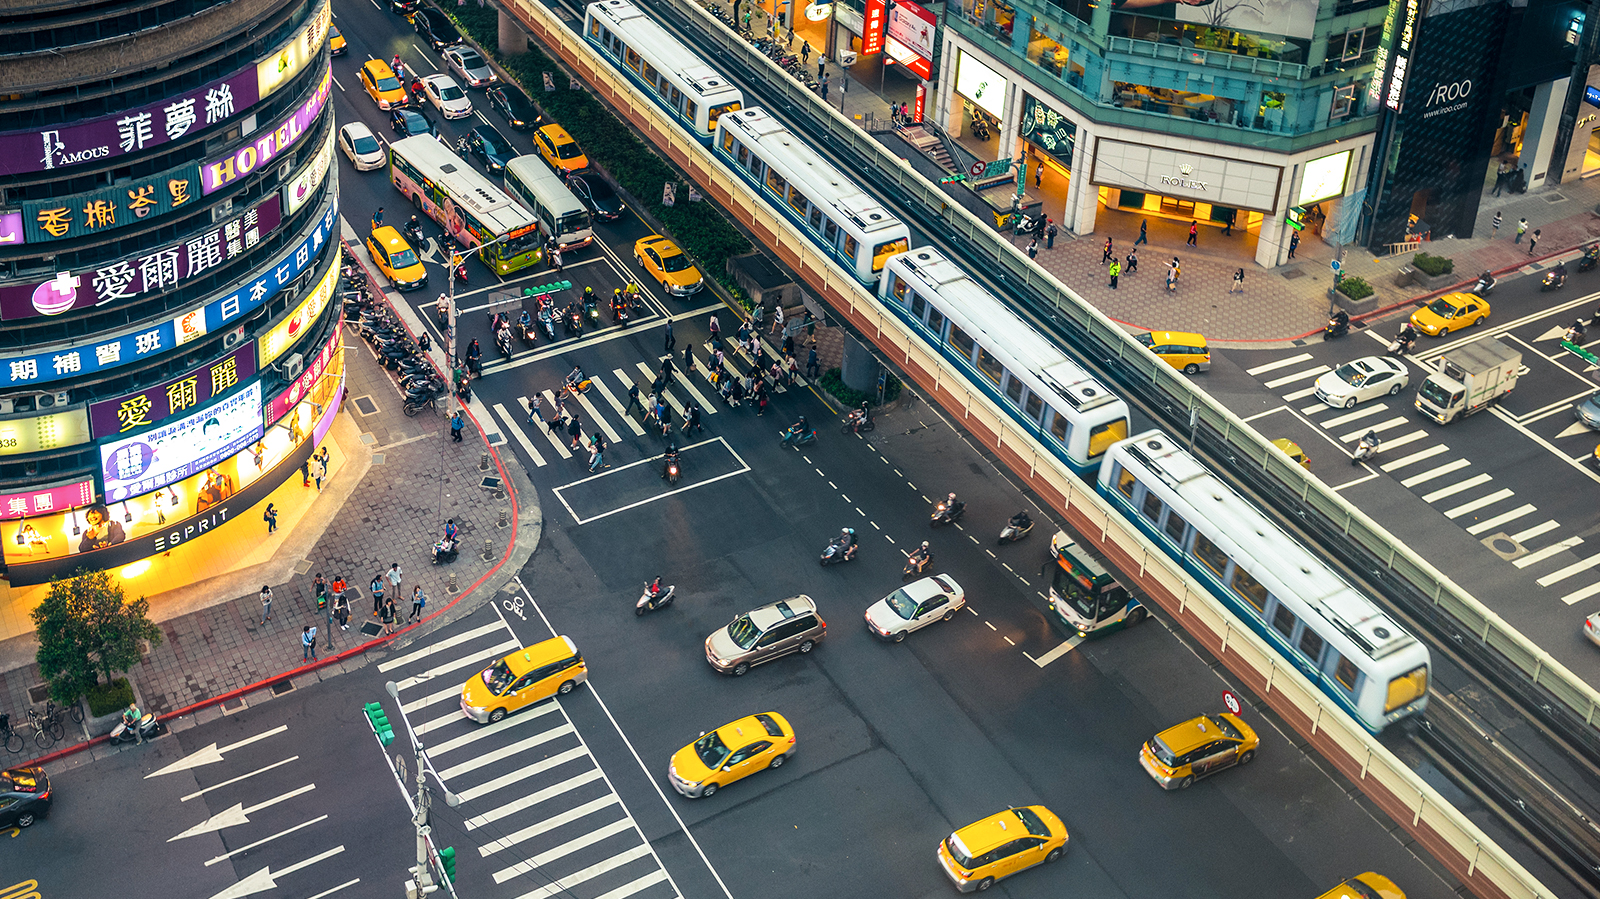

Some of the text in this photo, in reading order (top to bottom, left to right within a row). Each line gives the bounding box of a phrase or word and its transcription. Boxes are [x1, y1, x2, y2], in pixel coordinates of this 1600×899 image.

[117, 83, 235, 153] 菲夢絲
[1424, 102, 1468, 119] www.iroo.com
[211, 114, 302, 189] HOTEL
[37, 179, 193, 237] 香榭峇里
[1160, 174, 1208, 191] ROLEX
[93, 228, 223, 307] 愛爾麗
[10, 329, 161, 382] 期補習班
[117, 355, 239, 433] 愛爾麗
[0, 492, 53, 516] 集團
[155, 508, 228, 551] ESPRIT
